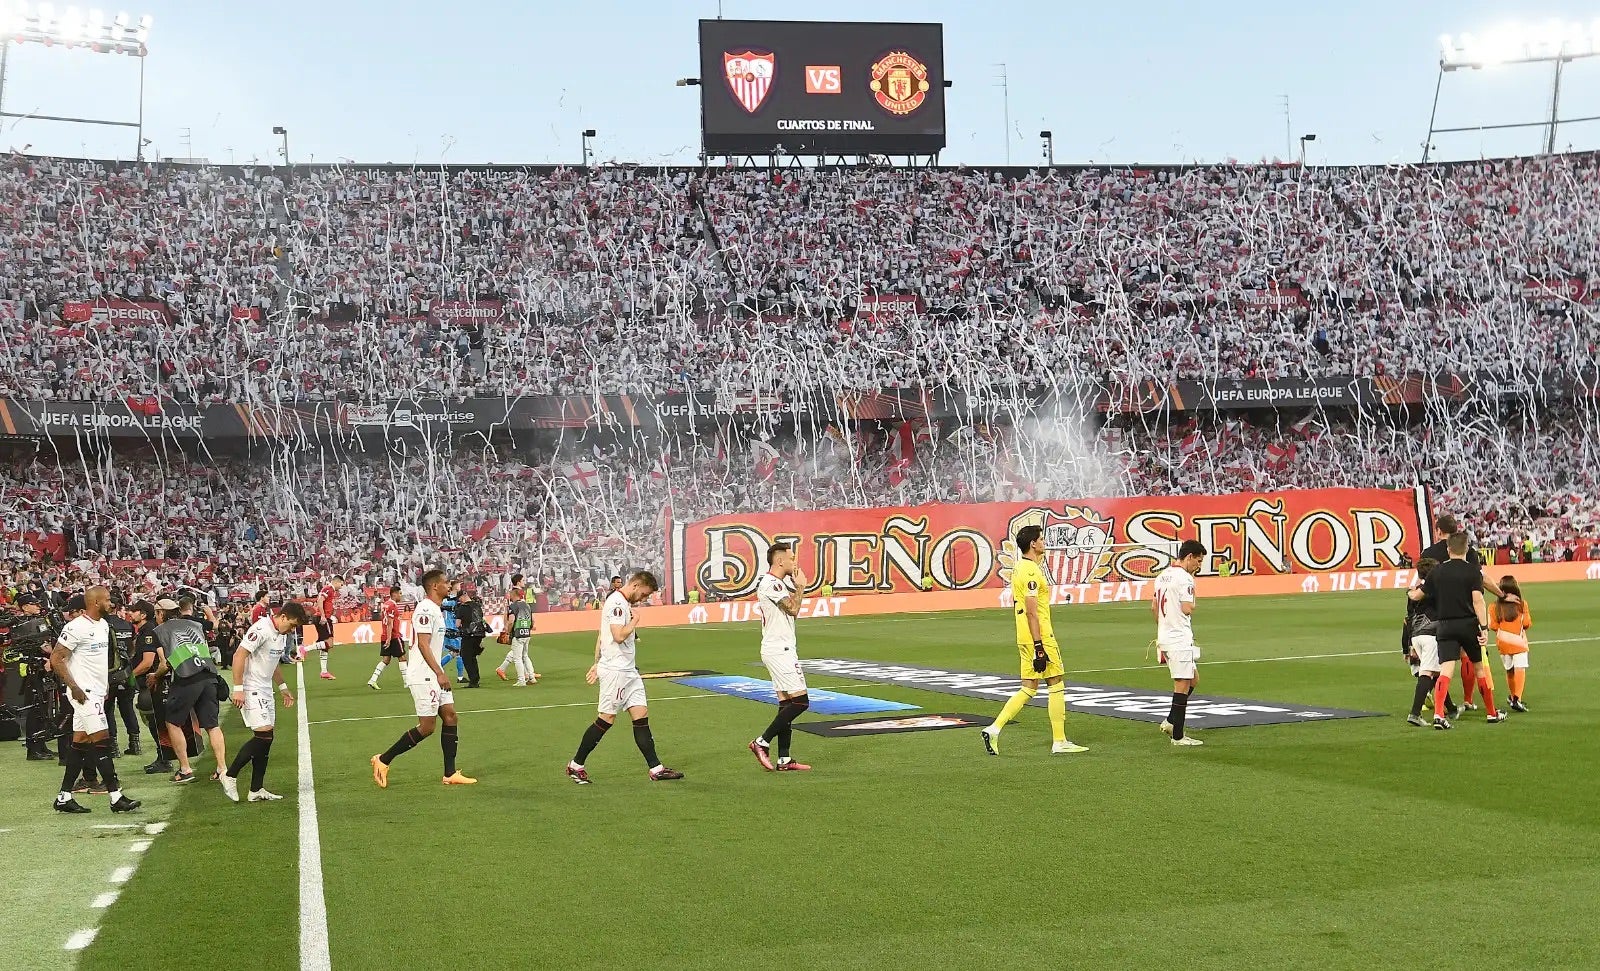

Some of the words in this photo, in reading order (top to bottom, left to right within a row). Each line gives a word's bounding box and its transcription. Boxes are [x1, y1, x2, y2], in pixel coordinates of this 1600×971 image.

[876, 56, 923, 76] MANCHESTER
[808, 69, 840, 91] VS
[885, 99, 917, 110] UNITED
[777, 120, 825, 130] CUARTOS
[827, 120, 842, 130] DE
[843, 120, 874, 130] FINAL
[109, 308, 162, 320] DEGIRO
[1214, 389, 1245, 400] UEFA
[1247, 388, 1294, 400] EUROPA
[1298, 387, 1343, 398] LEAGUE
[42, 413, 79, 426] UEFA
[82, 415, 140, 427] EUROPA
[143, 417, 201, 428] LEAGUE
[698, 516, 994, 597] DUEÑO
[1115, 499, 1404, 582] SEÑOR
[1328, 571, 1388, 592] JUST
[1098, 580, 1148, 602] EAT
